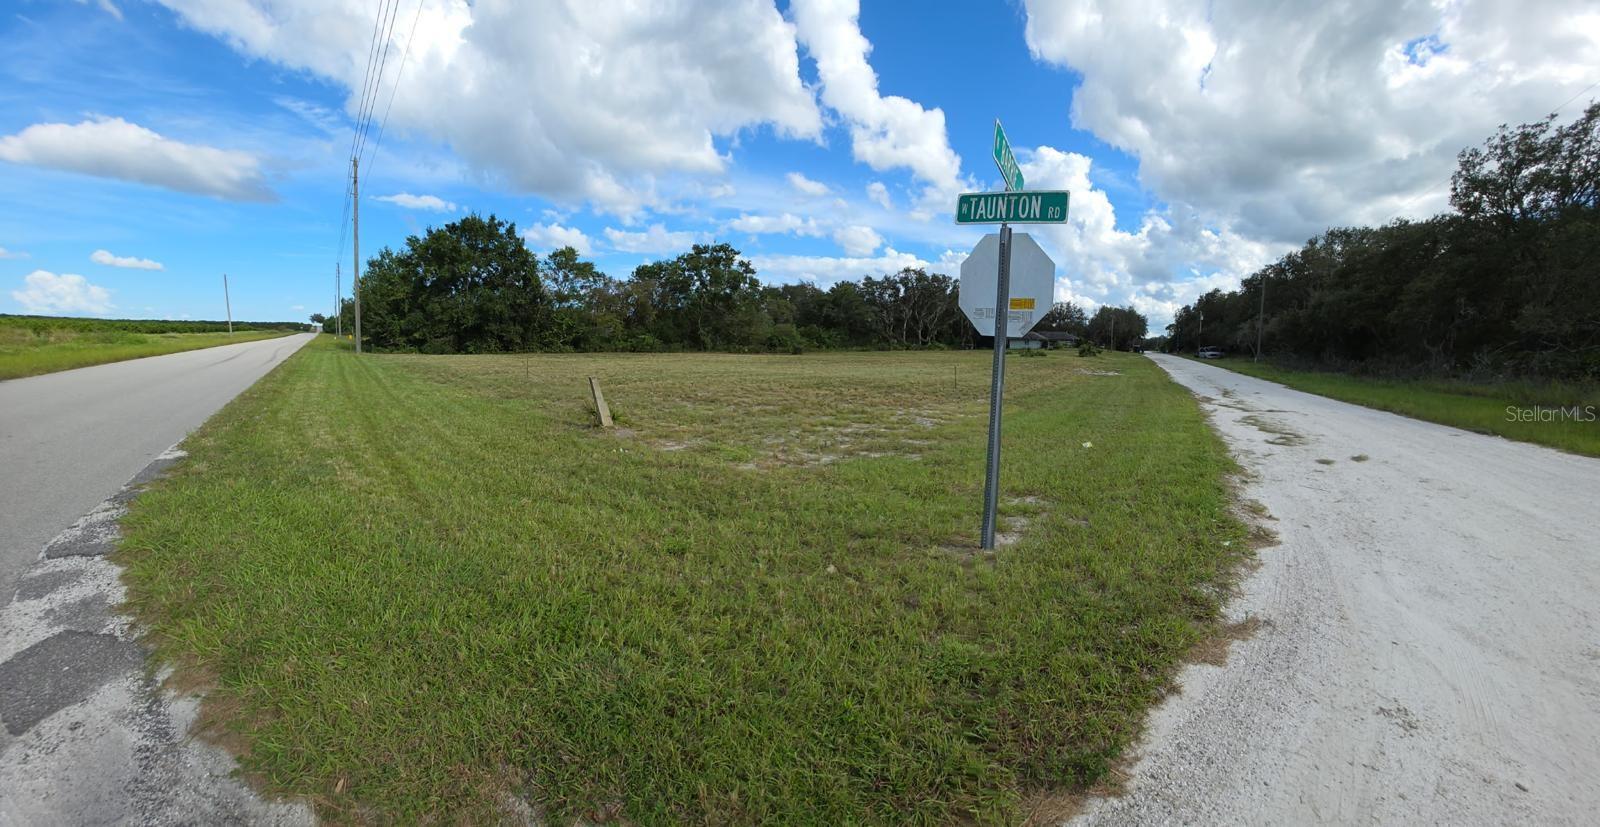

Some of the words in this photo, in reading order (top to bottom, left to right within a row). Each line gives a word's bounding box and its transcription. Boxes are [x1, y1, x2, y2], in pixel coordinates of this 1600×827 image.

[962, 203, 968, 214] W
[970, 195, 1042, 219] TAUNTON
[1048, 206, 1060, 219] RD
